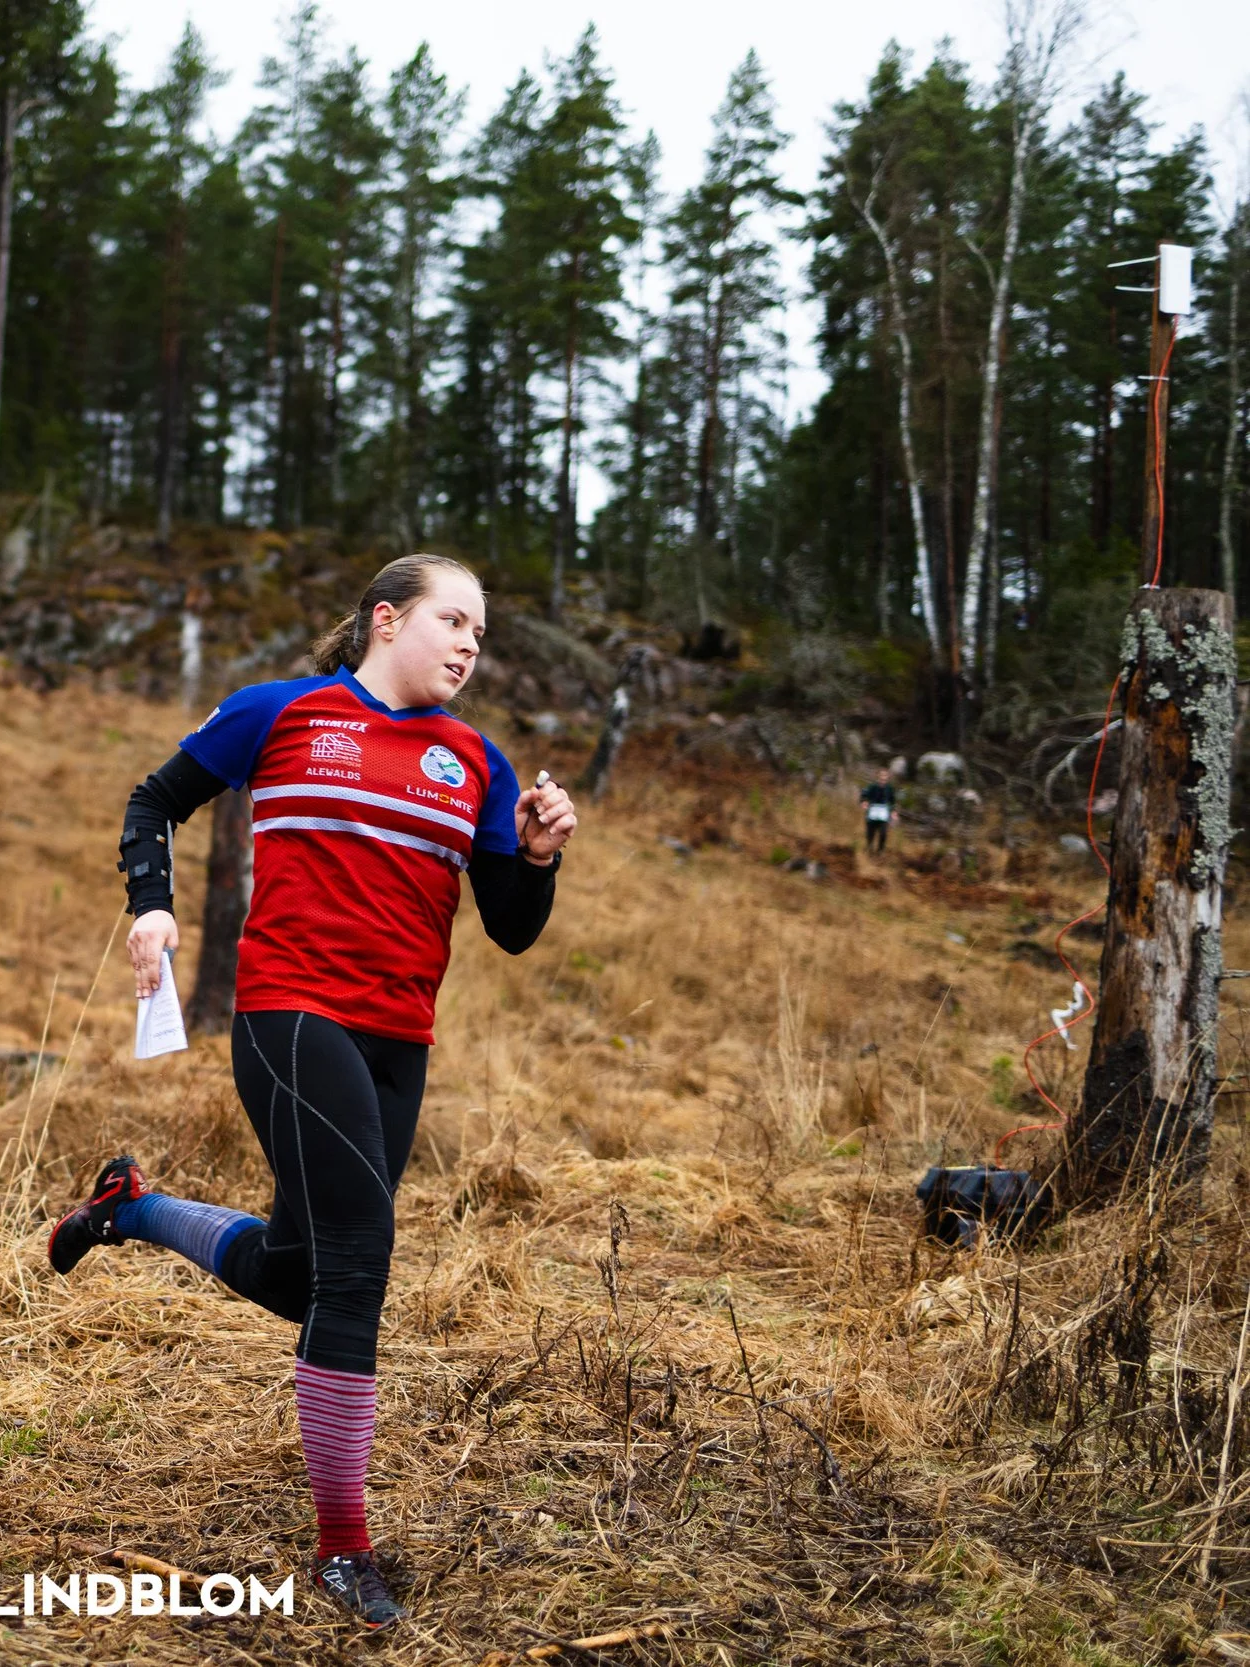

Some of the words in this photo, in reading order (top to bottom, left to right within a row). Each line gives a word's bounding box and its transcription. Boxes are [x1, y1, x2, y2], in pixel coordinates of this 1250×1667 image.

[309, 719, 369, 733] TRIMTEX
[306, 767, 361, 781] ALEWALDS
[406, 784, 473, 815] LUMONITE
